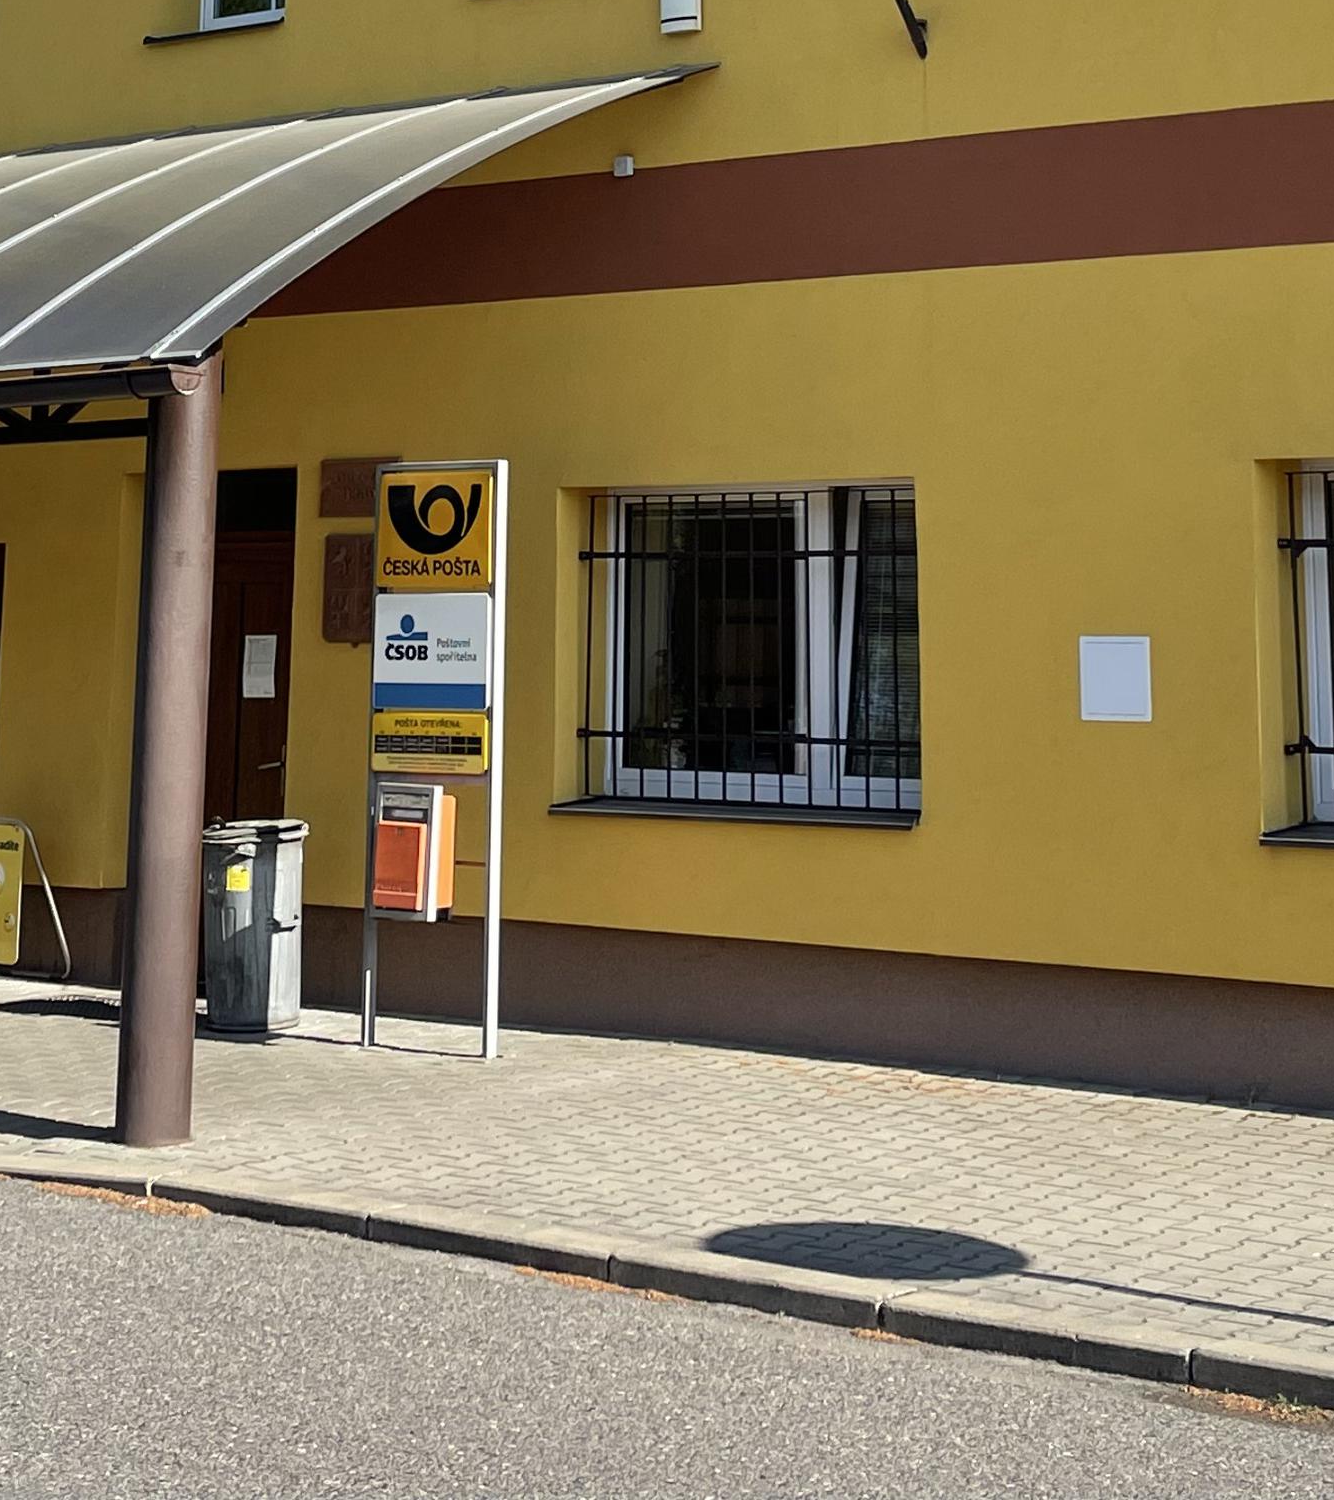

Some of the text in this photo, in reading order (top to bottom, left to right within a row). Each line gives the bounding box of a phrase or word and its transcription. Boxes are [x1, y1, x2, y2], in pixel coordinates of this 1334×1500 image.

[383, 557, 481, 576] ČESKÁ POŠTA
[385, 643, 428, 661] ČSOB
[436, 638, 471, 649] Poštovní
